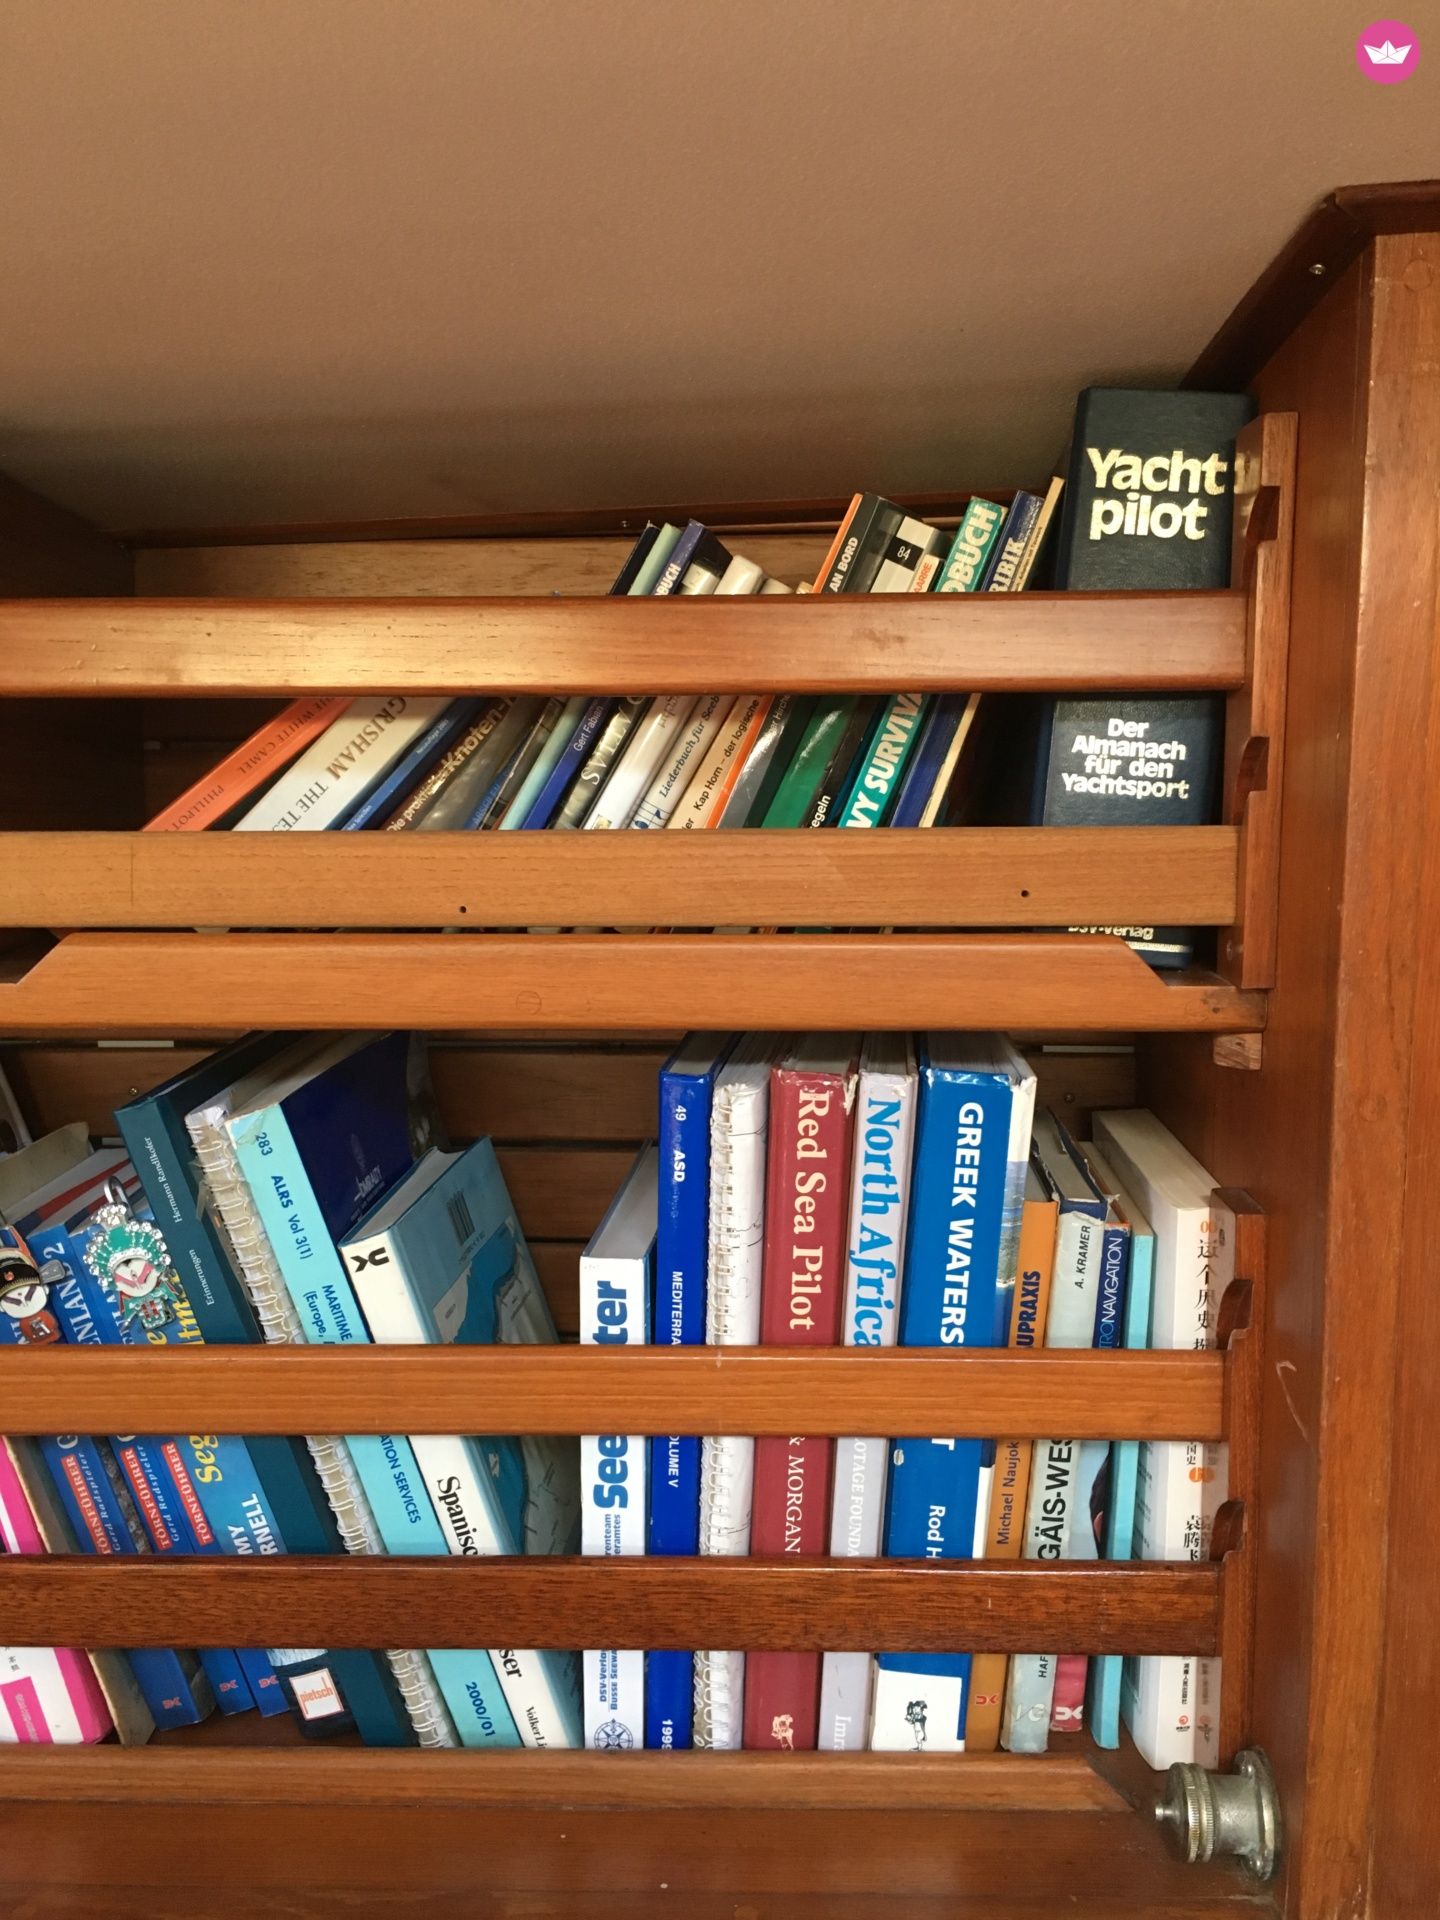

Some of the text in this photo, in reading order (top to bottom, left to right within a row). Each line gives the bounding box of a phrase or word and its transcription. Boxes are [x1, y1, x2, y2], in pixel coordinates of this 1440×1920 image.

[1086, 448, 1229, 495] Yacht
[1089, 491, 1207, 541] pilot
[654, 563, 681, 595] BUCH
[829, 537, 859, 592] AN BORD
[897, 546, 911, 560] 84
[325, 696, 407, 781] GRISHAM
[573, 728, 590, 752] Gert
[1071, 735, 1187, 760] Almanach
[1108, 718, 1149, 738] Der
[237, 740, 277, 775] CAMEL
[659, 738, 697, 798] Liederbuch
[693, 789, 711, 811] Kap
[724, 741, 737, 759] der
[736, 699, 760, 742] logische
[1084, 755, 1174, 778] für den
[296, 781, 329, 813] THE
[1061, 773, 1190, 800] Yachtsport
[675, 1105, 686, 1121] 49
[256, 1132, 273, 1156] 283
[673, 1150, 685, 1182] ASD
[144, 1136, 183, 1224] Hermann Randlkofer
[271, 1175, 315, 1260] ALRS Vol 3(1)
[789, 1088, 829, 1331] Red Sea Pilot
[850, 1097, 901, 1346] North Africa
[940, 1102, 984, 1344] GREEK WATERS
[43, 1242, 65, 1260] 2
[188, 1249, 215, 1306] Erinnerungen
[1074, 1225, 1091, 1289] A. KRAMER
[303, 1290, 327, 1338] (Europe,
[322, 1284, 353, 1341] MARITIME
[671, 1271, 683, 1344] MEDITERRA
[1016, 1271, 1041, 1346] UPRAXIS
[79, 1452, 108, 1519] Radspieler
[125, 1448, 170, 1549] TÖRNFÜHRER
[137, 1446, 180, 1542] Gerd Radspieler
[166, 1441, 211, 1544] TÖRNFÜHRER
[393, 1471, 421, 1524] SERVICES
[668, 1479, 679, 1488] V
[785, 1455, 804, 1553] MORGAN
[927, 1505, 946, 1542] Rod
[997, 1493, 1014, 1545] Michael
[465, 1681, 496, 1737] 2000/01
[525, 1706, 541, 1738] Volker
